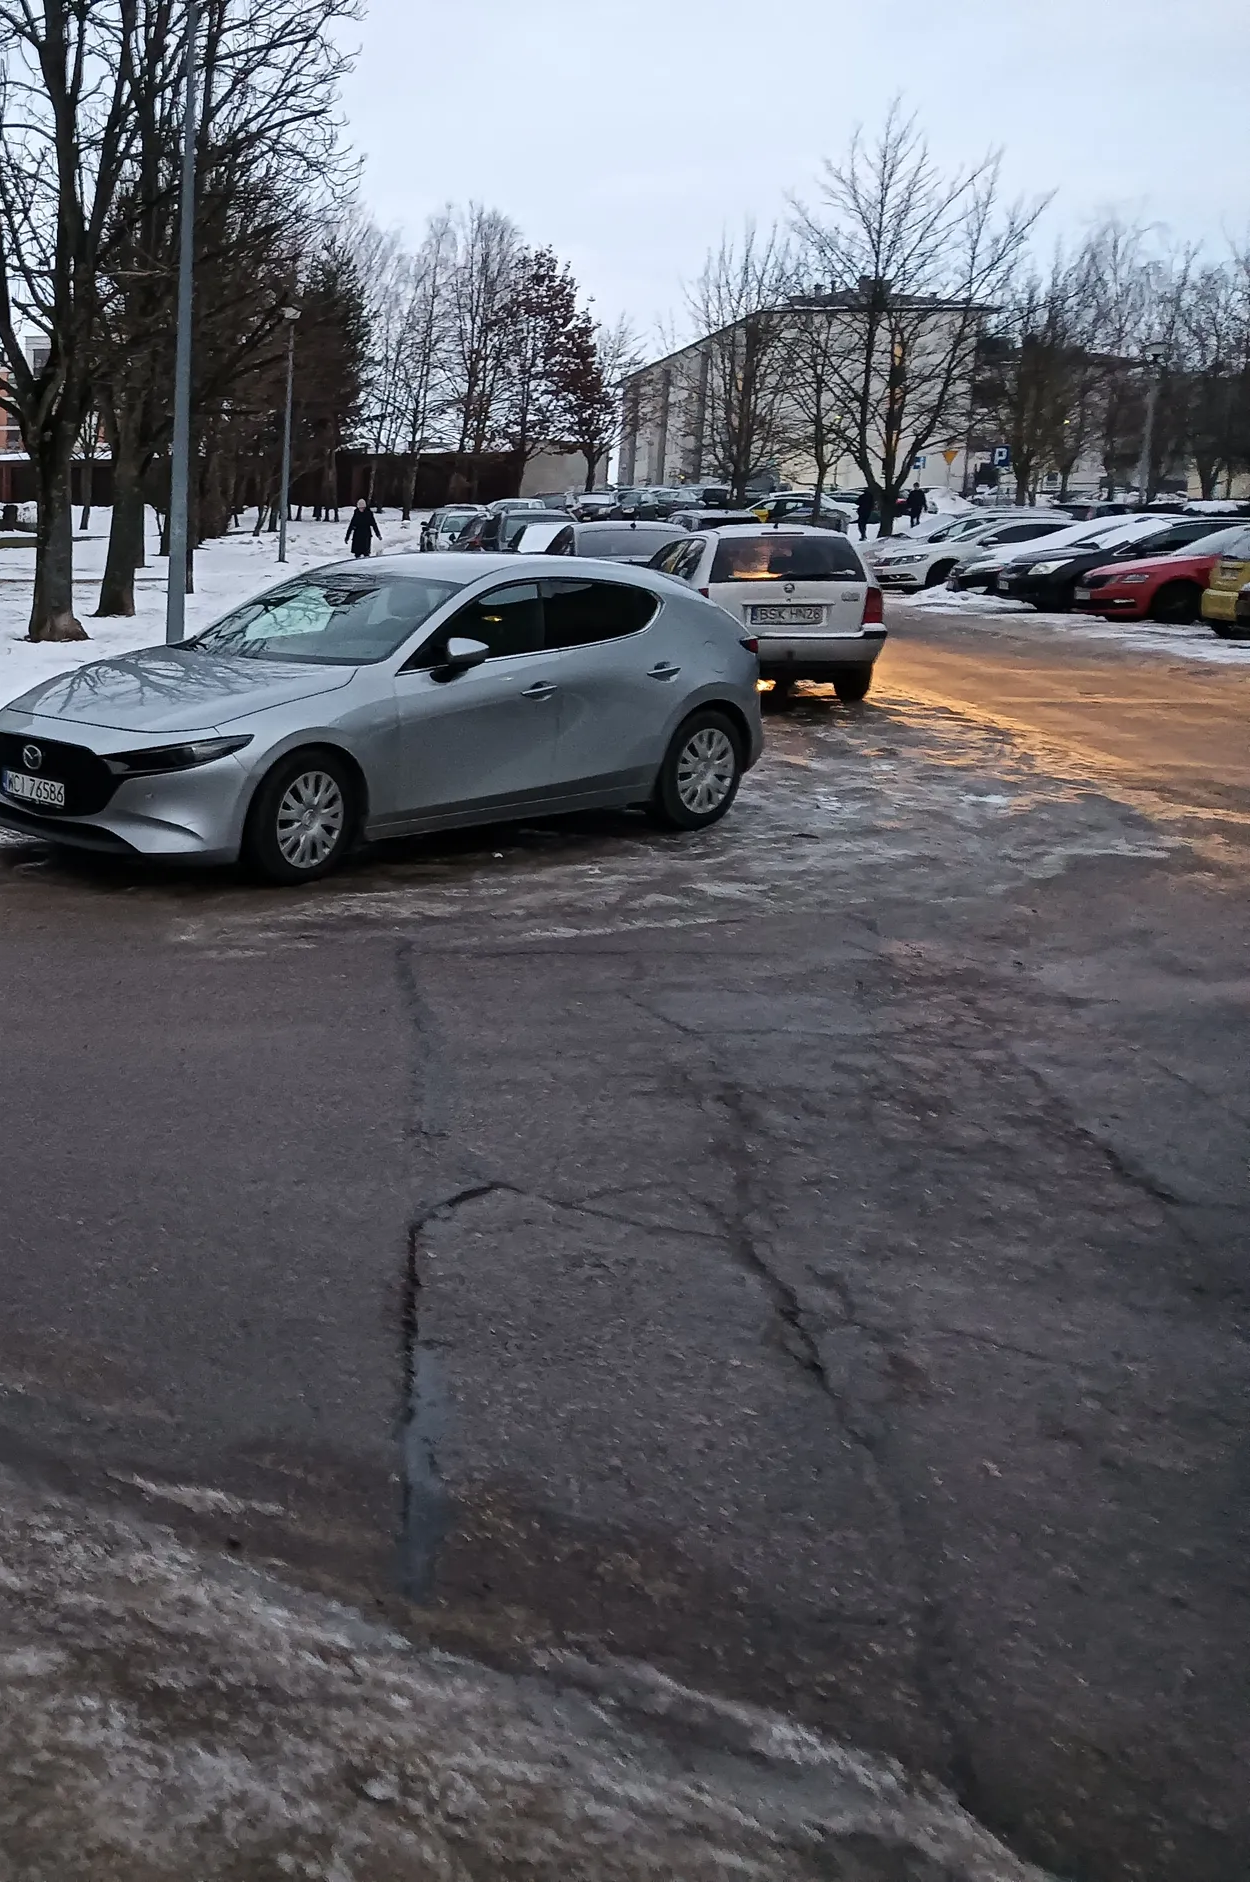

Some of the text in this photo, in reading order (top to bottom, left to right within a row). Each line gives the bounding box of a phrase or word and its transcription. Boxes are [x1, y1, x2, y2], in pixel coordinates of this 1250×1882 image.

[993, 447, 1008, 466] P
[760, 607, 786, 620] BSK
[29, 778, 64, 803] 76586
